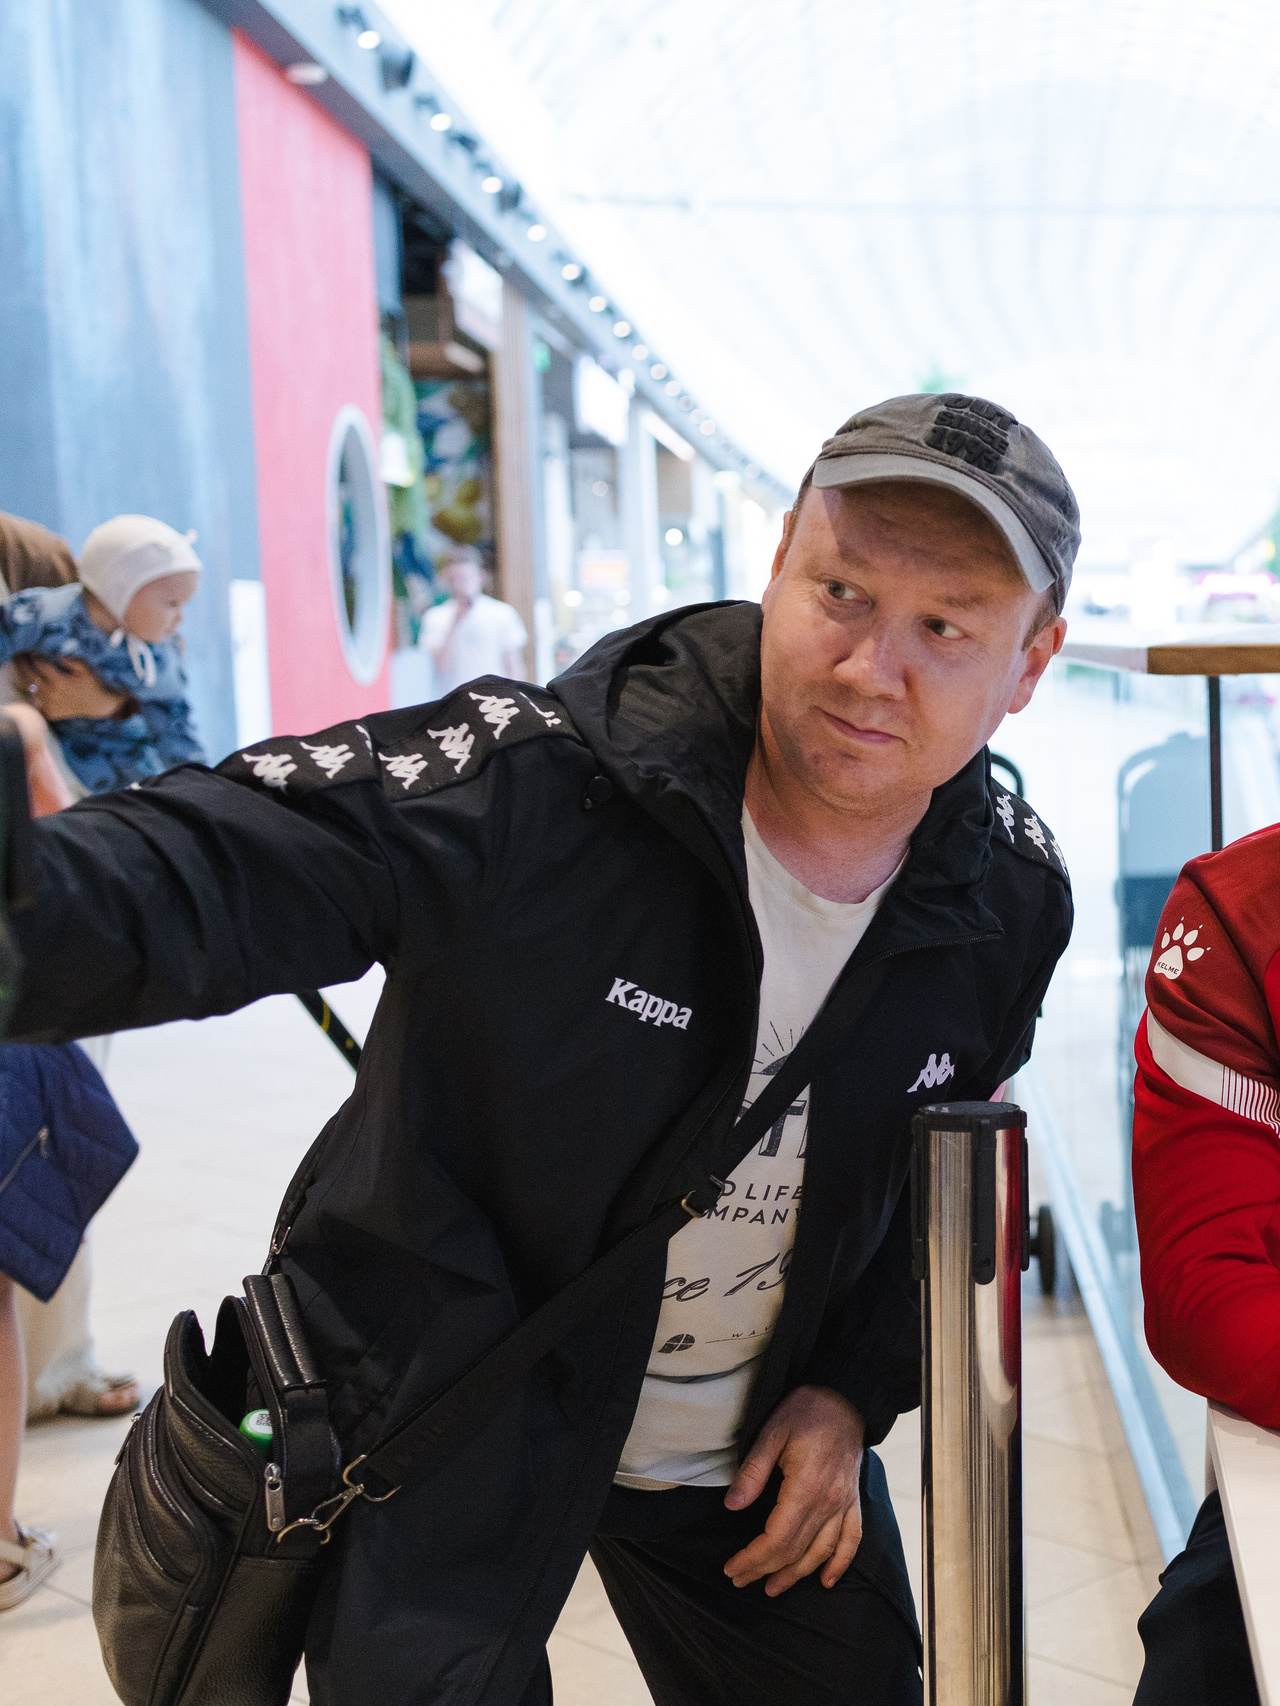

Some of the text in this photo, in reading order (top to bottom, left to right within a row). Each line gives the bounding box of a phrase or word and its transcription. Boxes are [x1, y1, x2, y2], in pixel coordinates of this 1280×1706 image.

[1157, 961, 1180, 975] KELME
[605, 977, 693, 1030] Kappa
[705, 1204, 801, 1225] MPAN
[723, 1248, 794, 1297] 19
[731, 1325, 774, 1339] WAV
